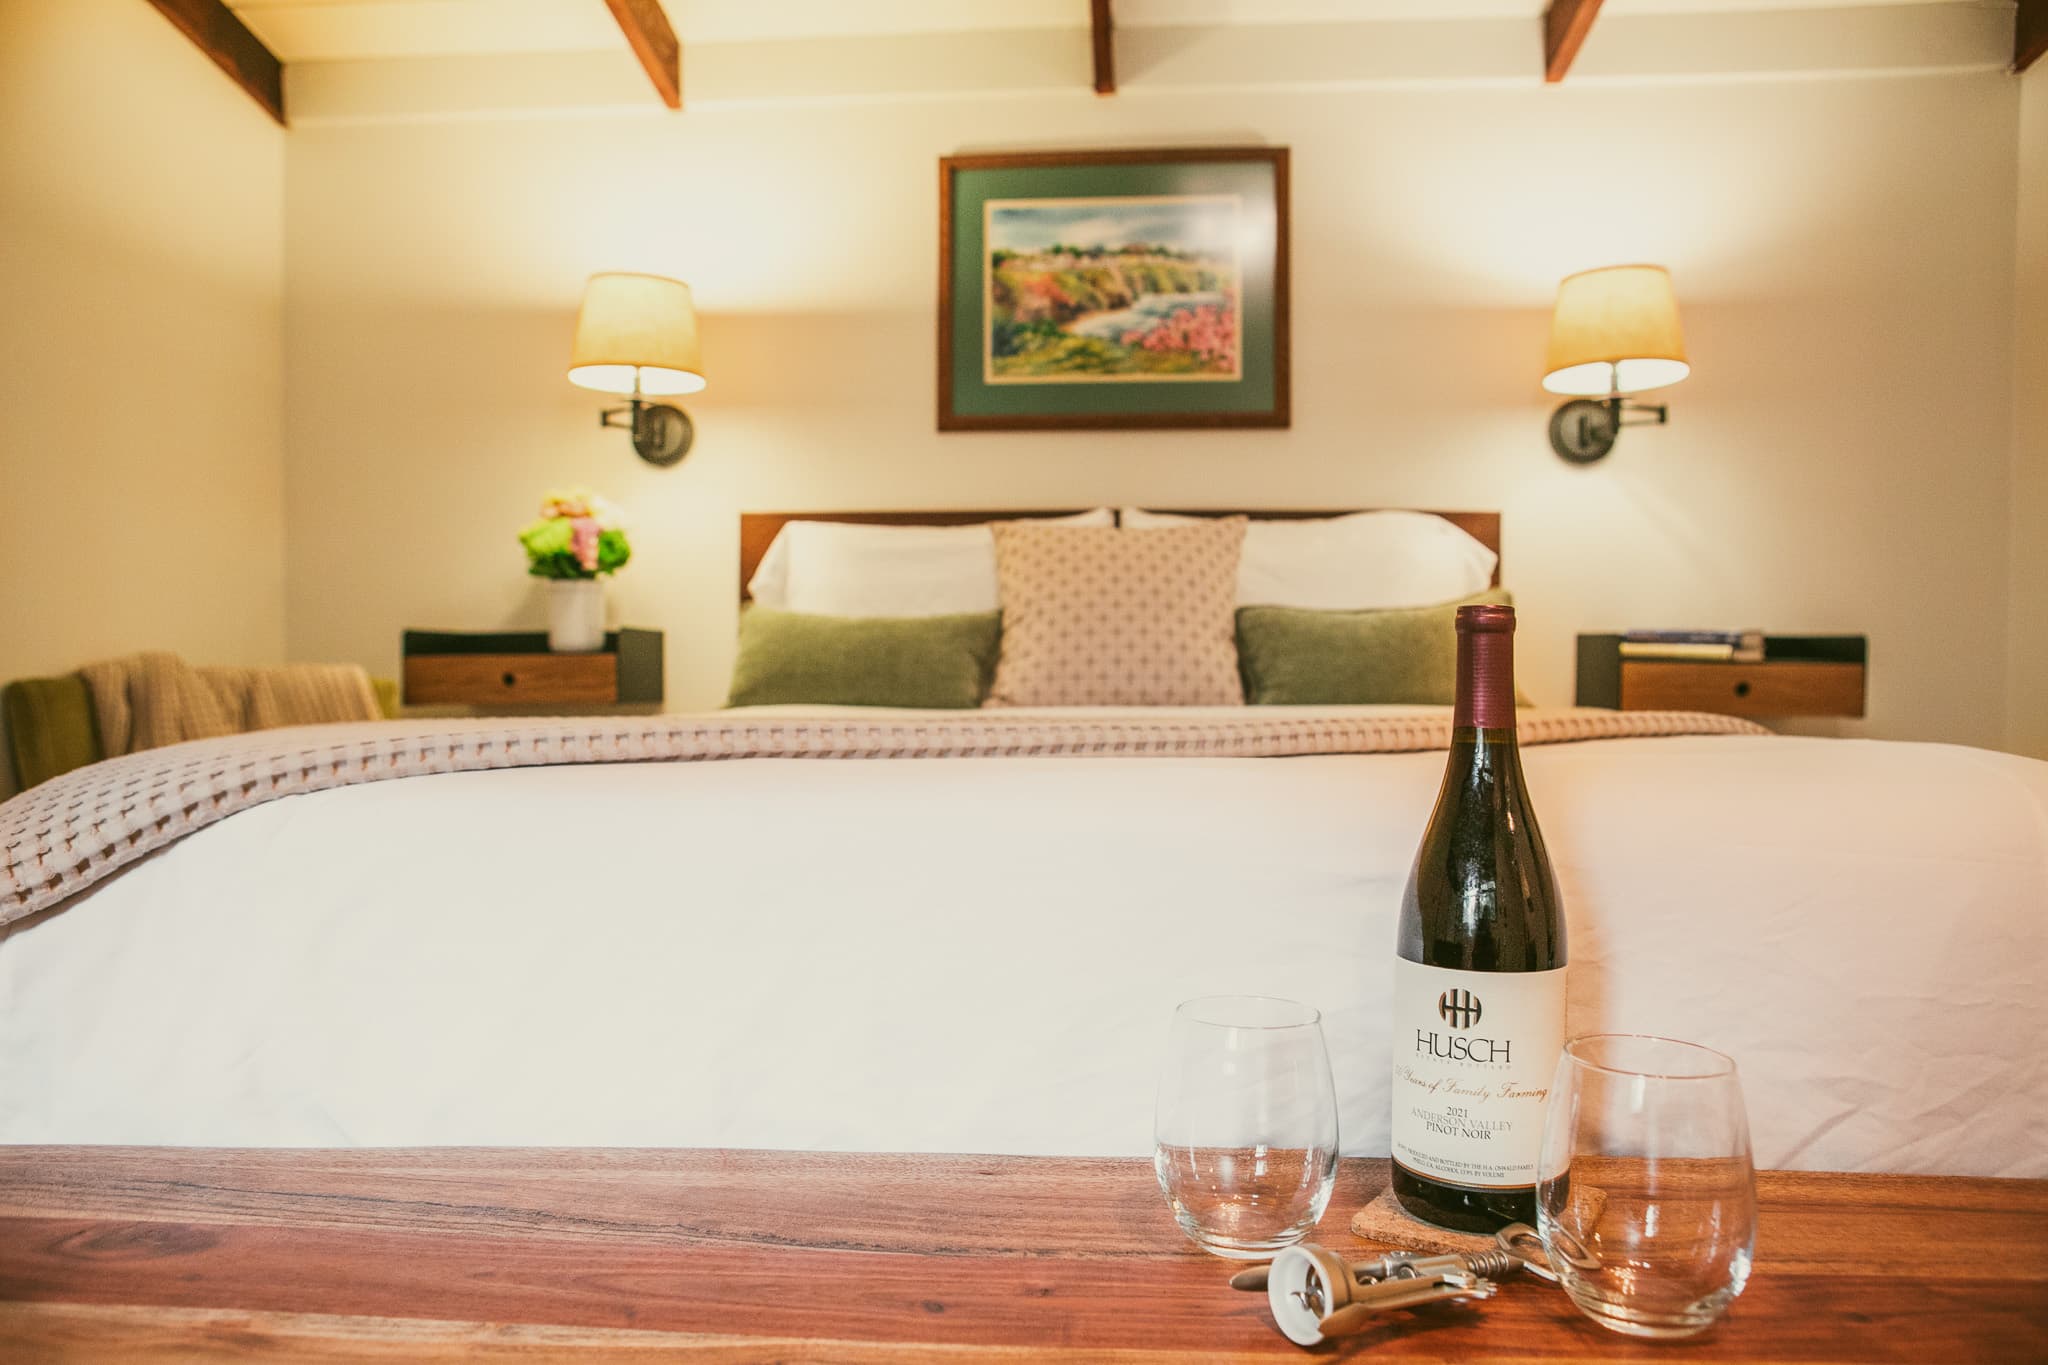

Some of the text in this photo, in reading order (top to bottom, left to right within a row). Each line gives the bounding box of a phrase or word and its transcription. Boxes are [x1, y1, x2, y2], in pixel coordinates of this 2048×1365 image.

[1416, 1029, 1511, 1062] HUSCH
[1428, 1079, 1442, 1093] of
[1442, 1078, 1489, 1104] Family
[1496, 1079, 1548, 1104] Farming
[1411, 1106, 1512, 1131] ANDERSON VALLEY
[1446, 1106, 1468, 1118] 2021
[1426, 1121, 1491, 1140] PINOT NOIR
